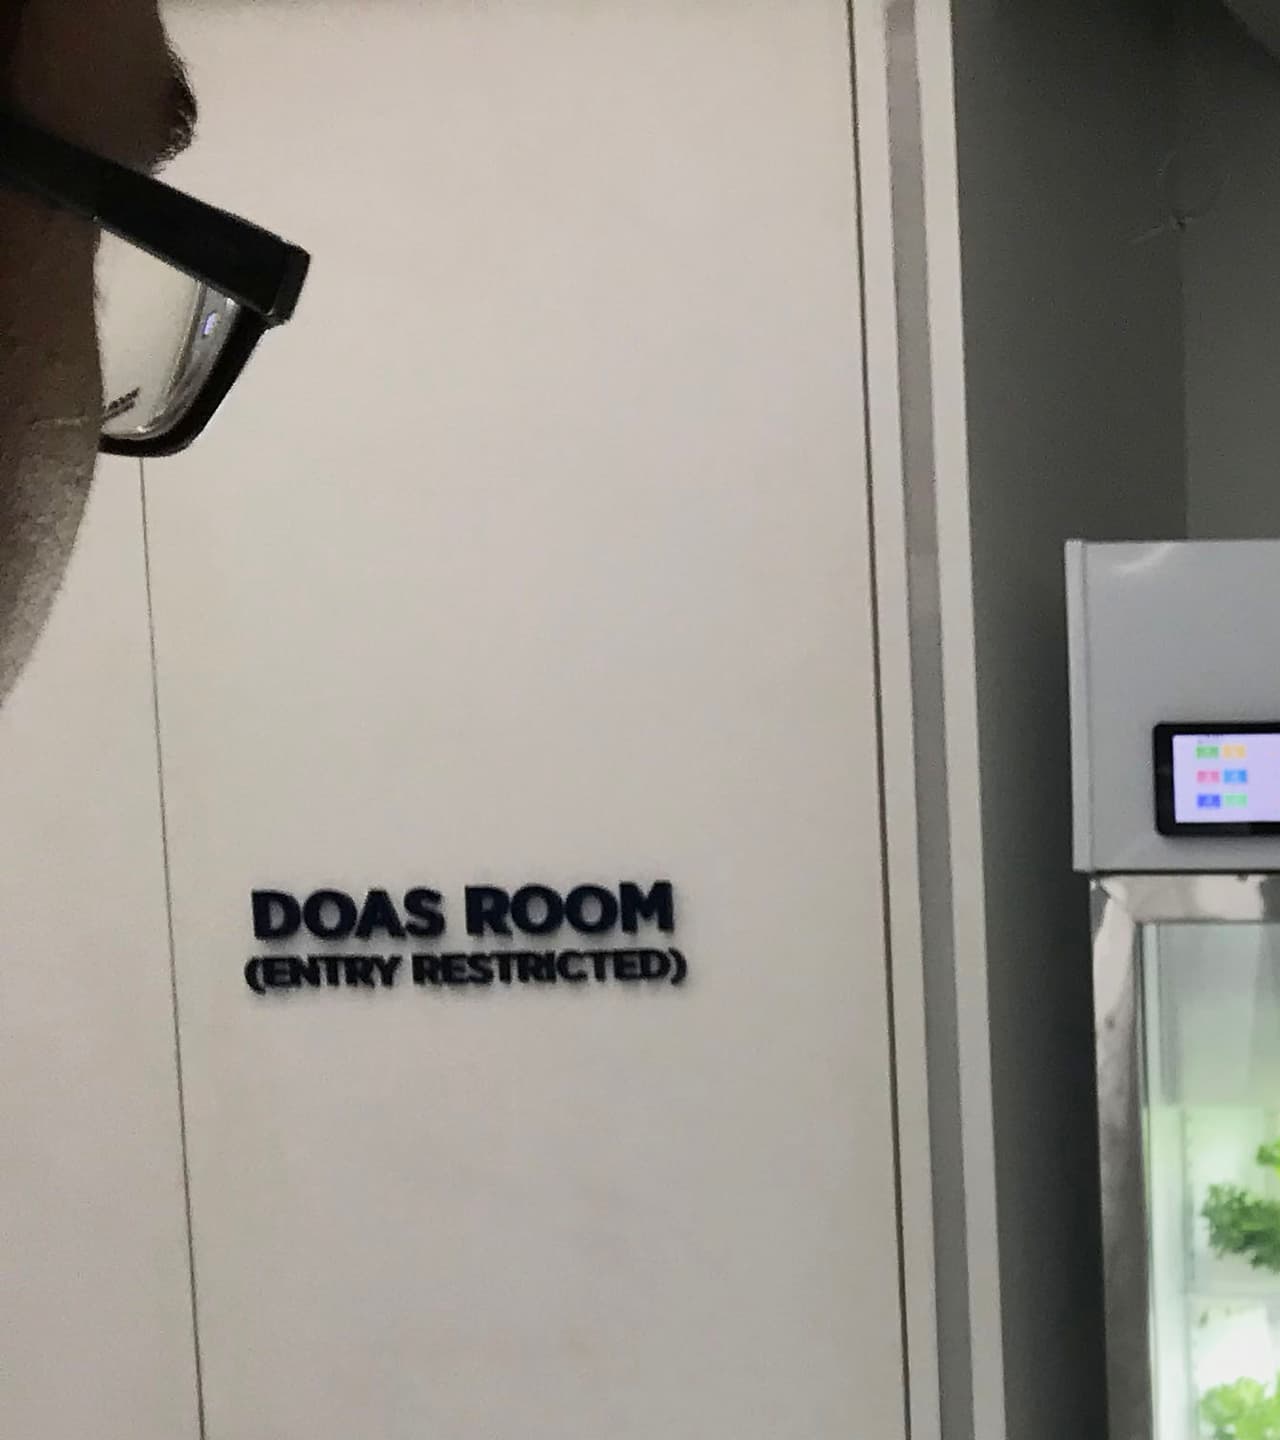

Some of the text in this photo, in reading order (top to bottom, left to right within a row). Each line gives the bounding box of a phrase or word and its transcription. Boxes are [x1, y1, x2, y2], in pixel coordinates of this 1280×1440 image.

[251, 881, 675, 940] DOAS ROOM
[244, 949, 687, 994] (ENTRY RESTRICTED)
